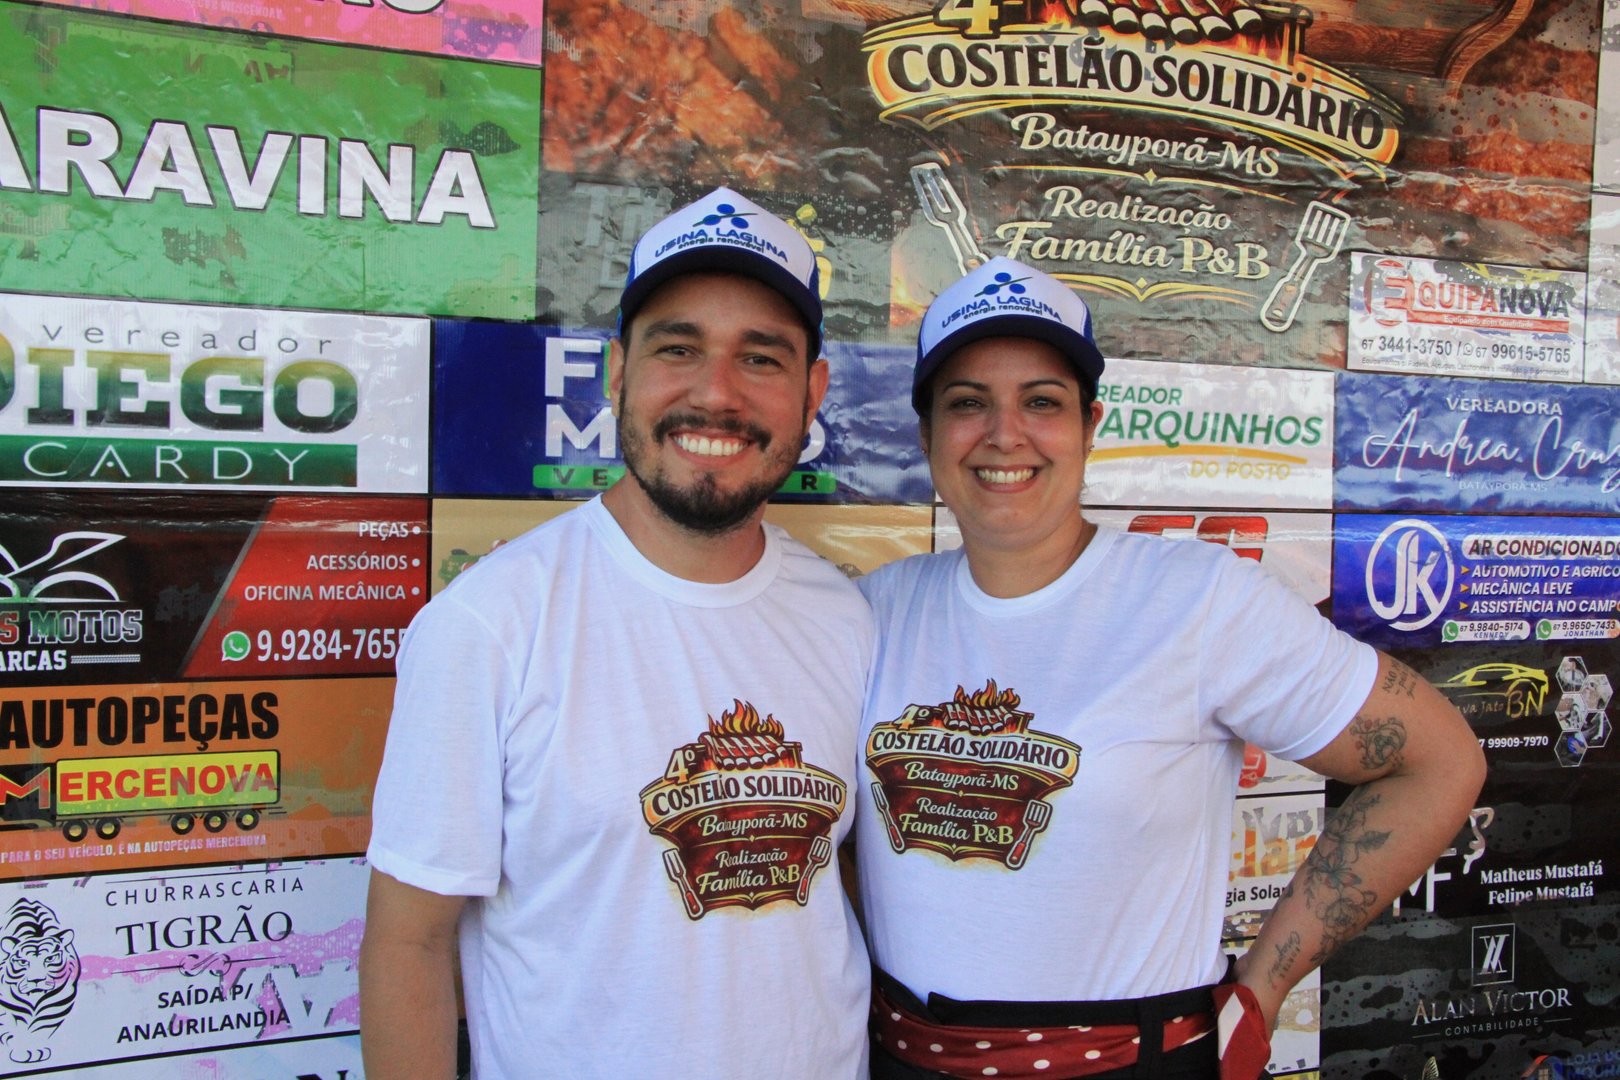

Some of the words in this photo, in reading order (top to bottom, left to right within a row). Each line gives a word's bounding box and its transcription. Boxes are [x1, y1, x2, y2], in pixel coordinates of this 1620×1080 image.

[888, 37, 1143, 93] COSTELÃO
[1152, 54, 1385, 150] SOLIDÁRIO
[1011, 112, 1280, 177] Batayporã-MS
[1045, 186, 1231, 233] Realização
[655, 229, 708, 258] USINA
[716, 227, 789, 263] LAGUNA
[995, 220, 1175, 267] Família
[1178, 237, 1271, 280] P&B
[942, 299, 991, 328] USINA
[997, 296, 1063, 322] LAGUNA
[42, 324, 332, 354] vereador
[1361, 338, 1373, 350] 67
[1378, 335, 1452, 356] 3441-3750
[1475, 346, 1487, 358] 67
[1491, 343, 1571, 363] 99615-5765
[0, 330, 359, 434] IEGO
[1446, 397, 1563, 416] VEREADORA
[1363, 407, 1519, 483] Andrea
[23, 443, 309, 482] CARDY
[1189, 460, 1219, 479] DO
[1226, 461, 1291, 481] POSTO
[358, 522, 409, 541] PEÇAS
[306, 552, 408, 572] ACESSÓRIOS
[1469, 539, 1492, 556] AR
[1471, 564, 1560, 578] AUTOMOTIVO
[1562, 565, 1570, 578] E
[244, 584, 314, 602] OFICINA
[319, 581, 406, 601] MECÂNICA
[1470, 579, 1540, 595] MECÂNICA
[1543, 582, 1573, 595] LEVE
[1470, 597, 1554, 614] ASSISTÊNCIA
[1557, 600, 1577, 613] NO
[28, 610, 143, 644] MOTOS
[1474, 631, 1509, 639] KENNEDY
[1563, 630, 1605, 638] JONATHAN
[0, 691, 279, 751] AUTOPEÇAS
[872, 731, 965, 755] COSTELÃO
[966, 738, 1071, 769] SOLIDÁRIO
[1487, 736, 1549, 749] 99909-7970
[743, 772, 843, 806] SOLIDÁRIO
[904, 760, 1019, 791] Batayporã-MS
[917, 796, 998, 822] Realização
[899, 813, 971, 842] Família
[971, 823, 1014, 844] P&B
[0, 850, 31, 864] PARA
[44, 847, 66, 860] SEU
[127, 841, 142, 854] NA
[143, 838, 204, 853] AUTOPEÇAS
[205, 834, 267, 849] MERCENOVA
[696, 870, 768, 895] Família
[769, 863, 801, 886] P&B
[1480, 867, 1542, 885] Matheus
[1545, 860, 1604, 880] Mustafá
[105, 876, 305, 907] CHURRASCARIA
[1488, 886, 1533, 907] Felipe
[1536, 881, 1594, 901] Mustafá
[114, 904, 294, 956] TIGRÃO
[157, 984, 227, 1010] SAÍDA
[1411, 999, 1476, 1027] ALAN
[1481, 988, 1573, 1018] VICTOR
[116, 1008, 292, 1044] ANAURILANDIA
[1445, 1017, 1540, 1037] CONTABILIDADE
